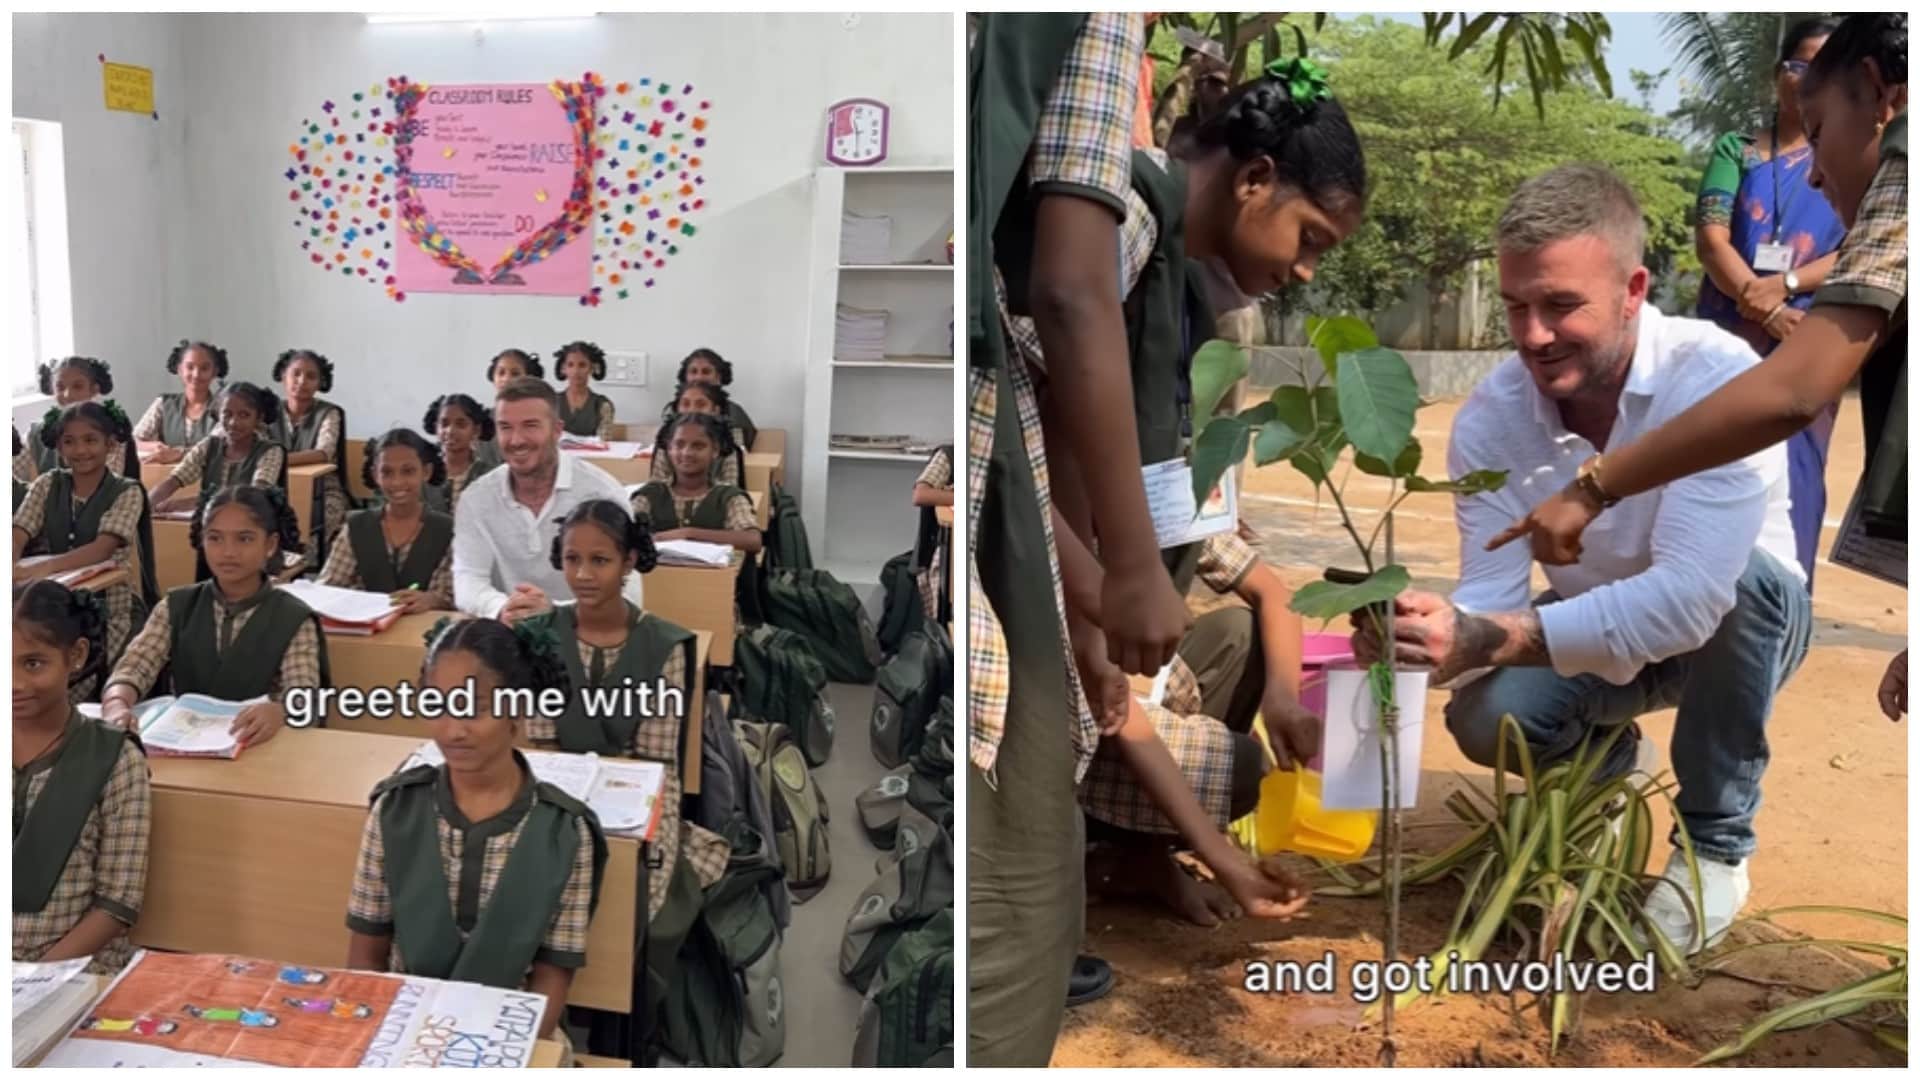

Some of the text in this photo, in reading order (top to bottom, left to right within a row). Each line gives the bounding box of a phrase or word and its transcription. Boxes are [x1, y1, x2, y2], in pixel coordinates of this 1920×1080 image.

[427, 88, 534, 105] CLASSROOM RULES
[514, 214, 535, 233] DO
